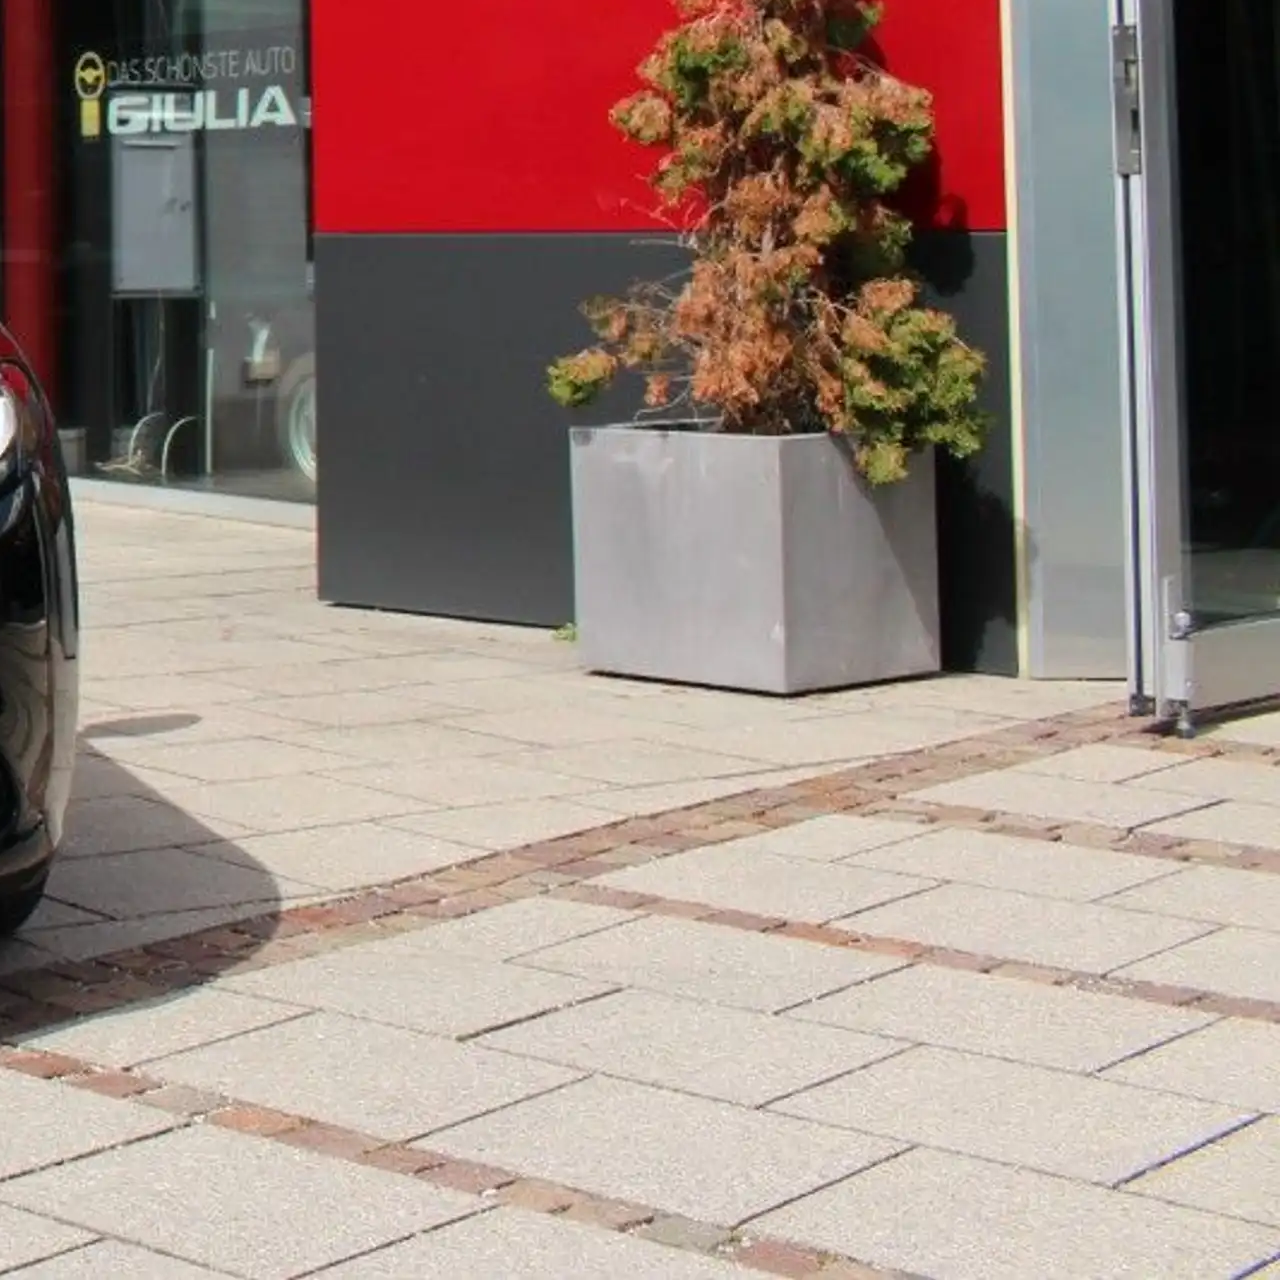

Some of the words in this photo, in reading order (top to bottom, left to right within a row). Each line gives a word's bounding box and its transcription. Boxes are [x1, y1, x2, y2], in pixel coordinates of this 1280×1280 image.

[108, 59, 141, 82] DAS
[245, 46, 296, 75] AUTO
[107, 85, 297, 134] GIULIA
